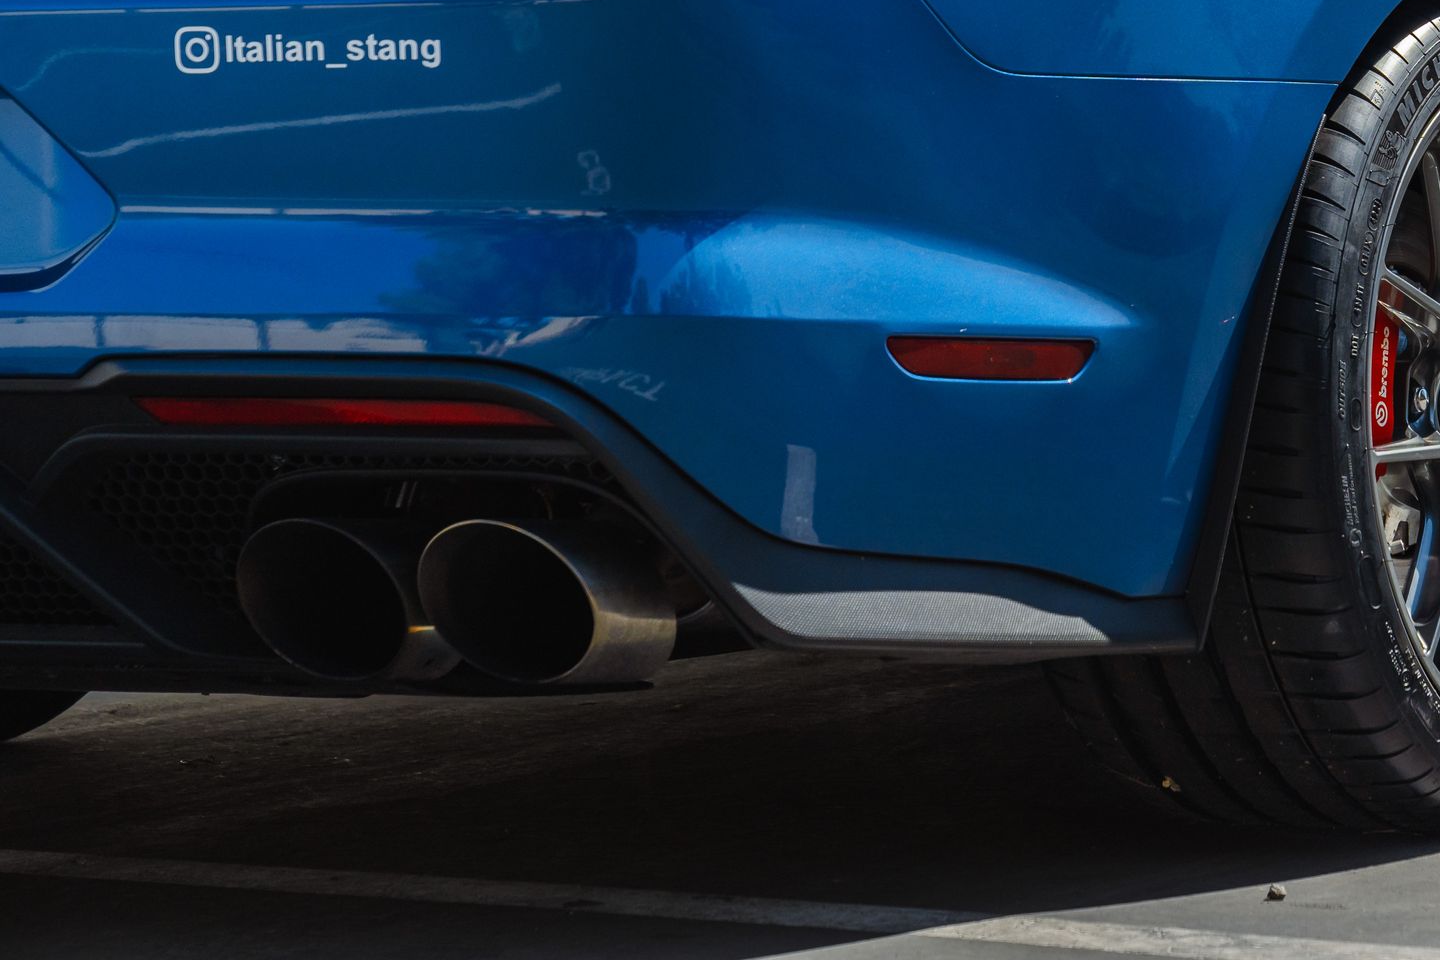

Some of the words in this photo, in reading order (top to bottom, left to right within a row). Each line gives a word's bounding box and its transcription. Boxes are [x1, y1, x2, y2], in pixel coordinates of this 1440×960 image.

[225, 33, 442, 68] Italian_stang
[1337, 359, 1347, 420] OUTSIDE
[1378, 326, 1390, 399] brembo
